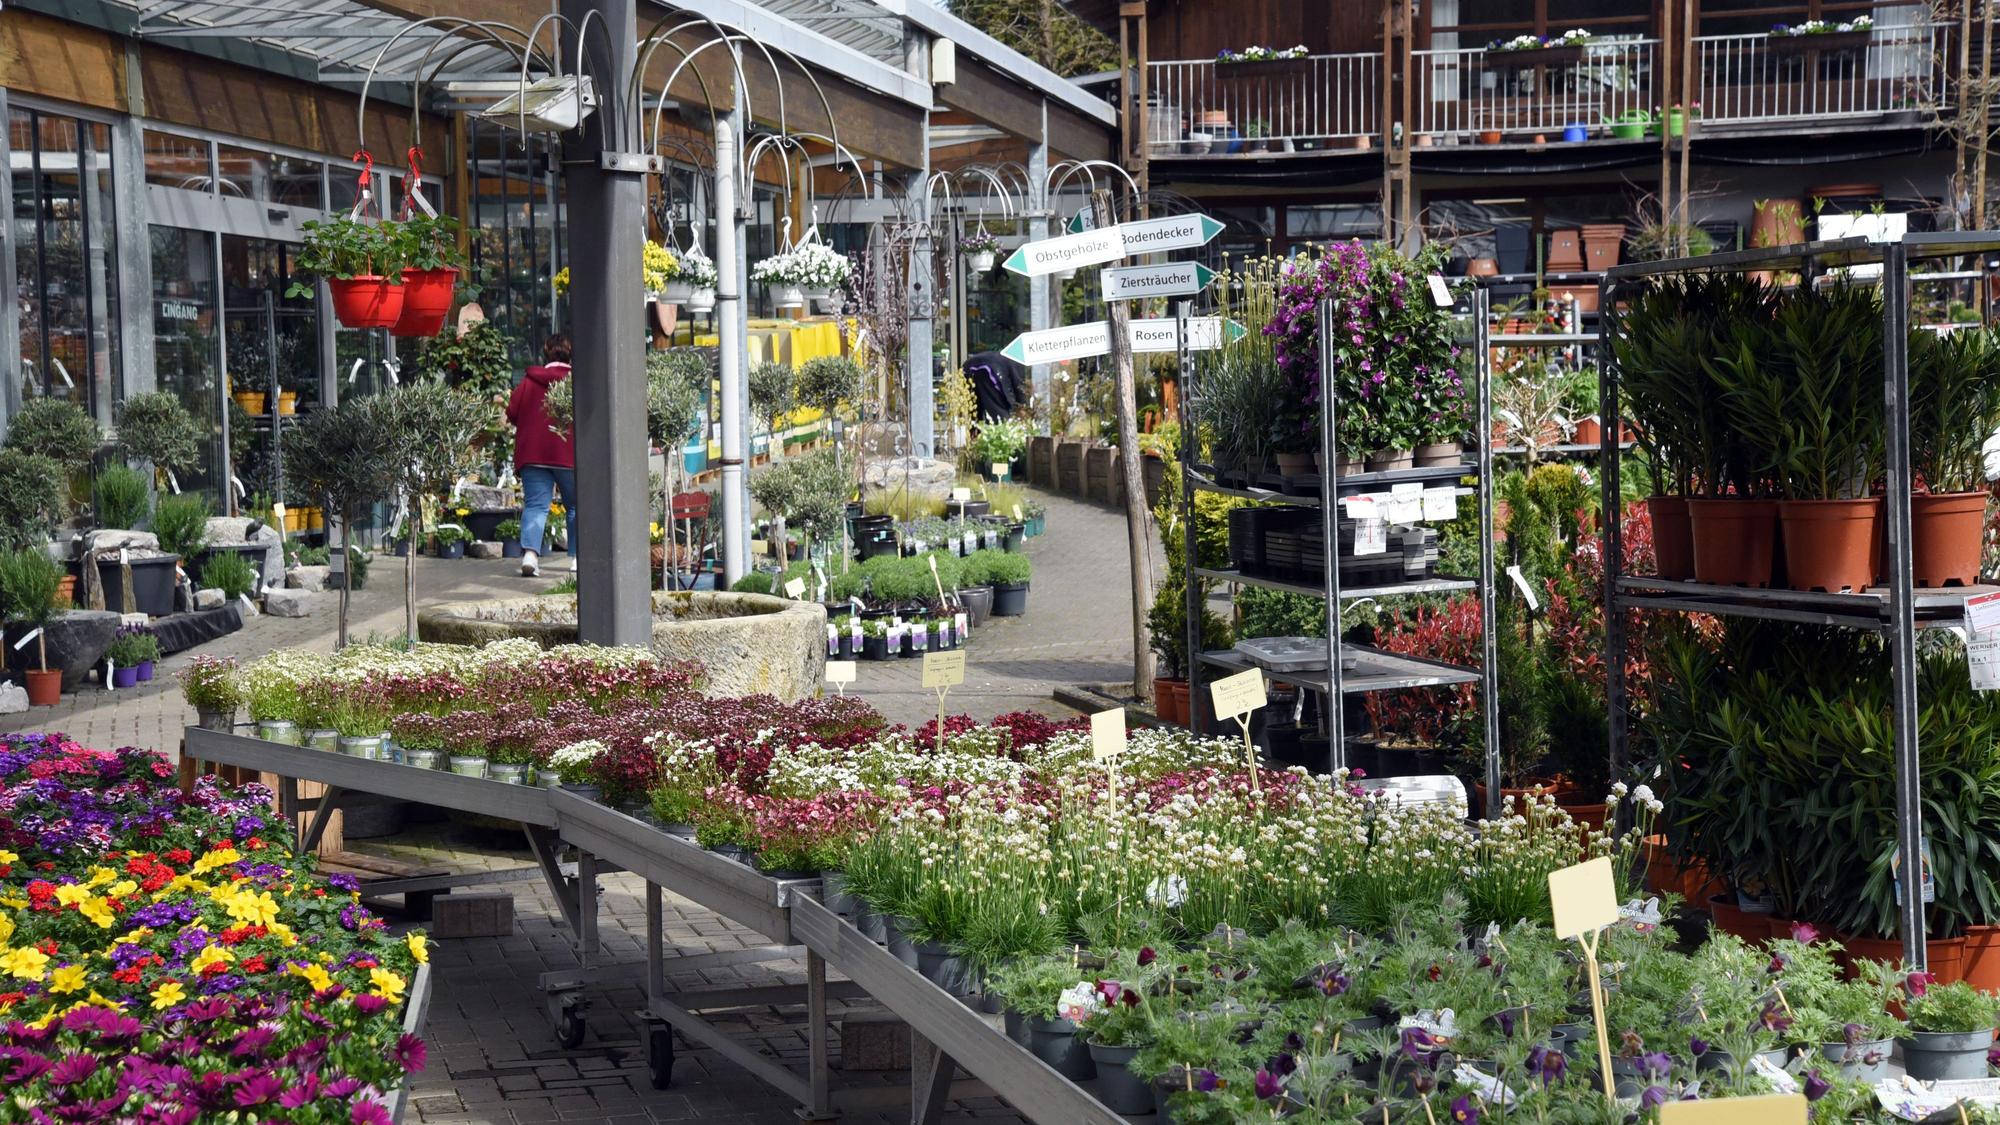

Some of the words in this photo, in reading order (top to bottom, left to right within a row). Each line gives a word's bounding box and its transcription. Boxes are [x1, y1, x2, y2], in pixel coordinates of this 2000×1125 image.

[1035, 241, 1109, 263] Obstgehölze
[1120, 272, 1191, 289] Ziersträucher
[162, 303, 198, 320] EINGANG
[1028, 332, 1106, 354] Kletterpflanzen
[1135, 329, 1173, 341] Rosen
